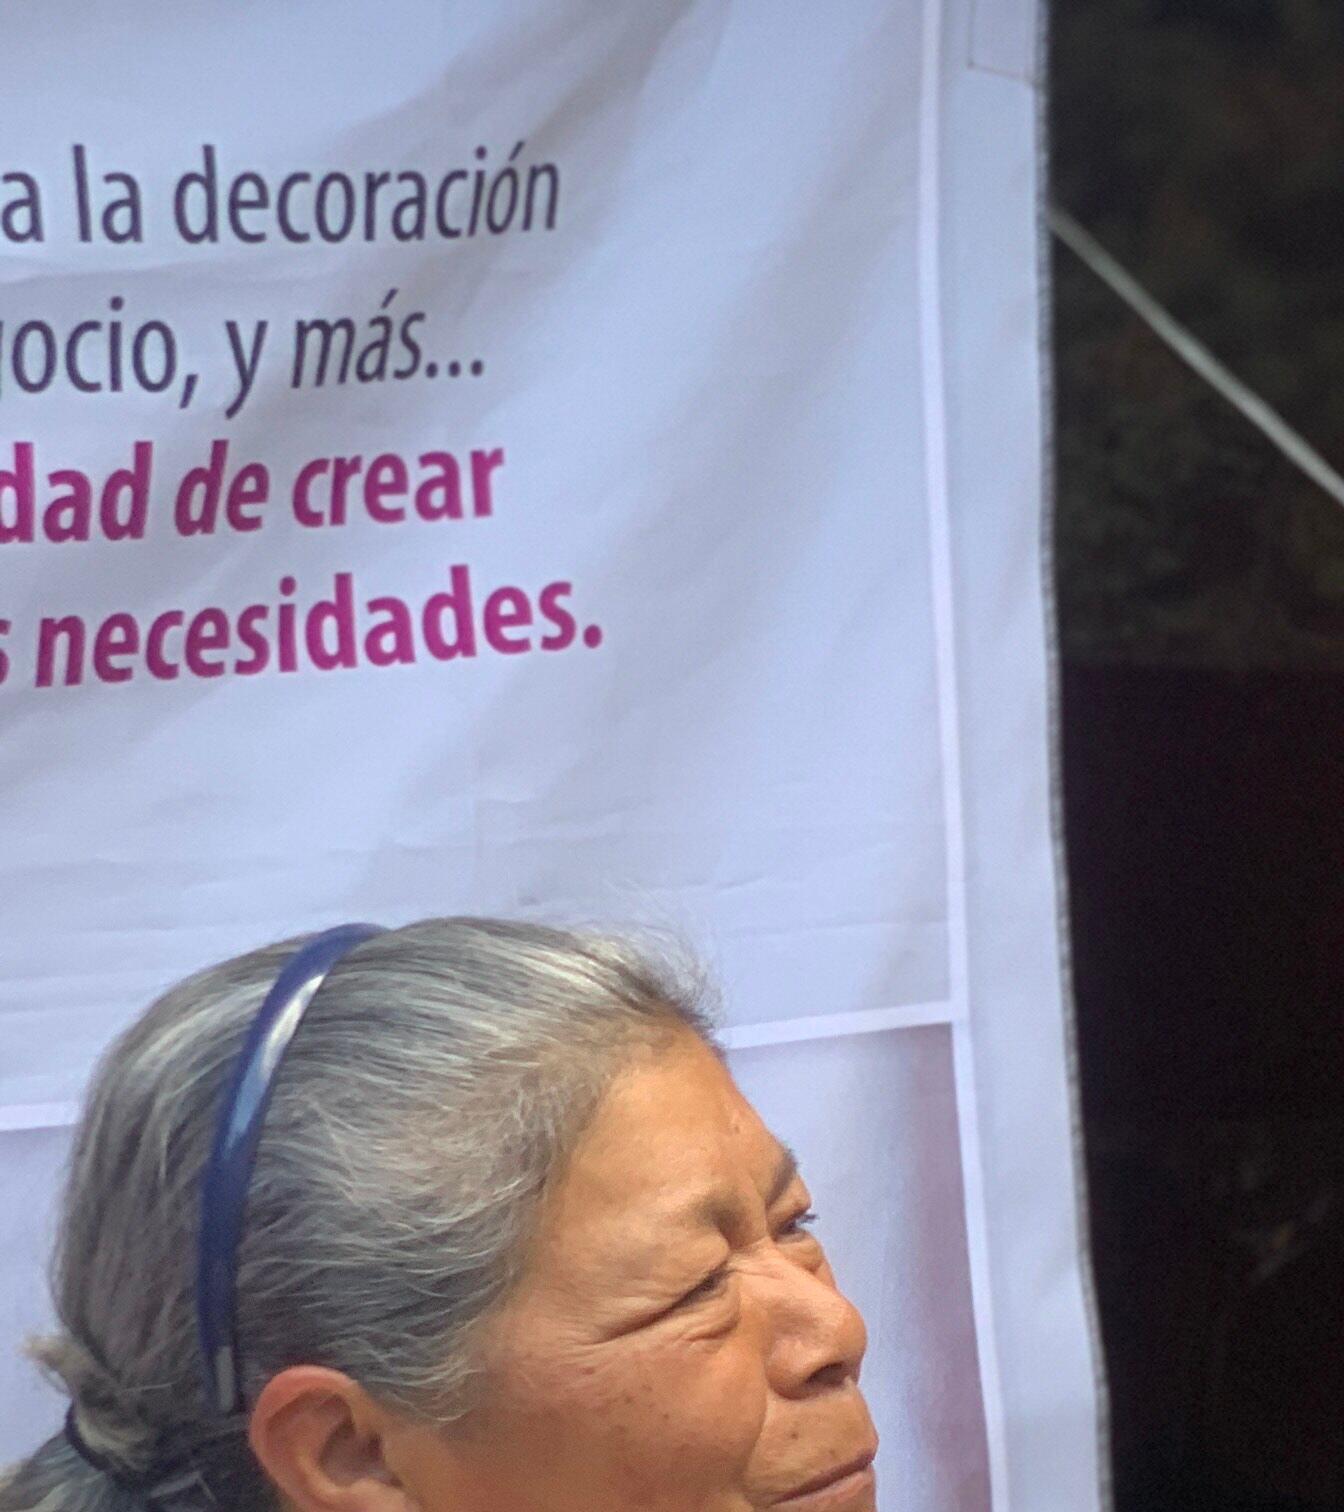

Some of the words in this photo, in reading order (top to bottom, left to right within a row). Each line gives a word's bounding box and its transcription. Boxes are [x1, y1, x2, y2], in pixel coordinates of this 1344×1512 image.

[72, 143, 143, 245] la
[174, 140, 560, 244] decoración
[0, 295, 198, 410] ocio,
[224, 320, 268, 420] y
[291, 287, 484, 389] más...
[174, 439, 270, 537] de
[291, 447, 504, 528] crear
[34, 564, 604, 688] necesidades.
